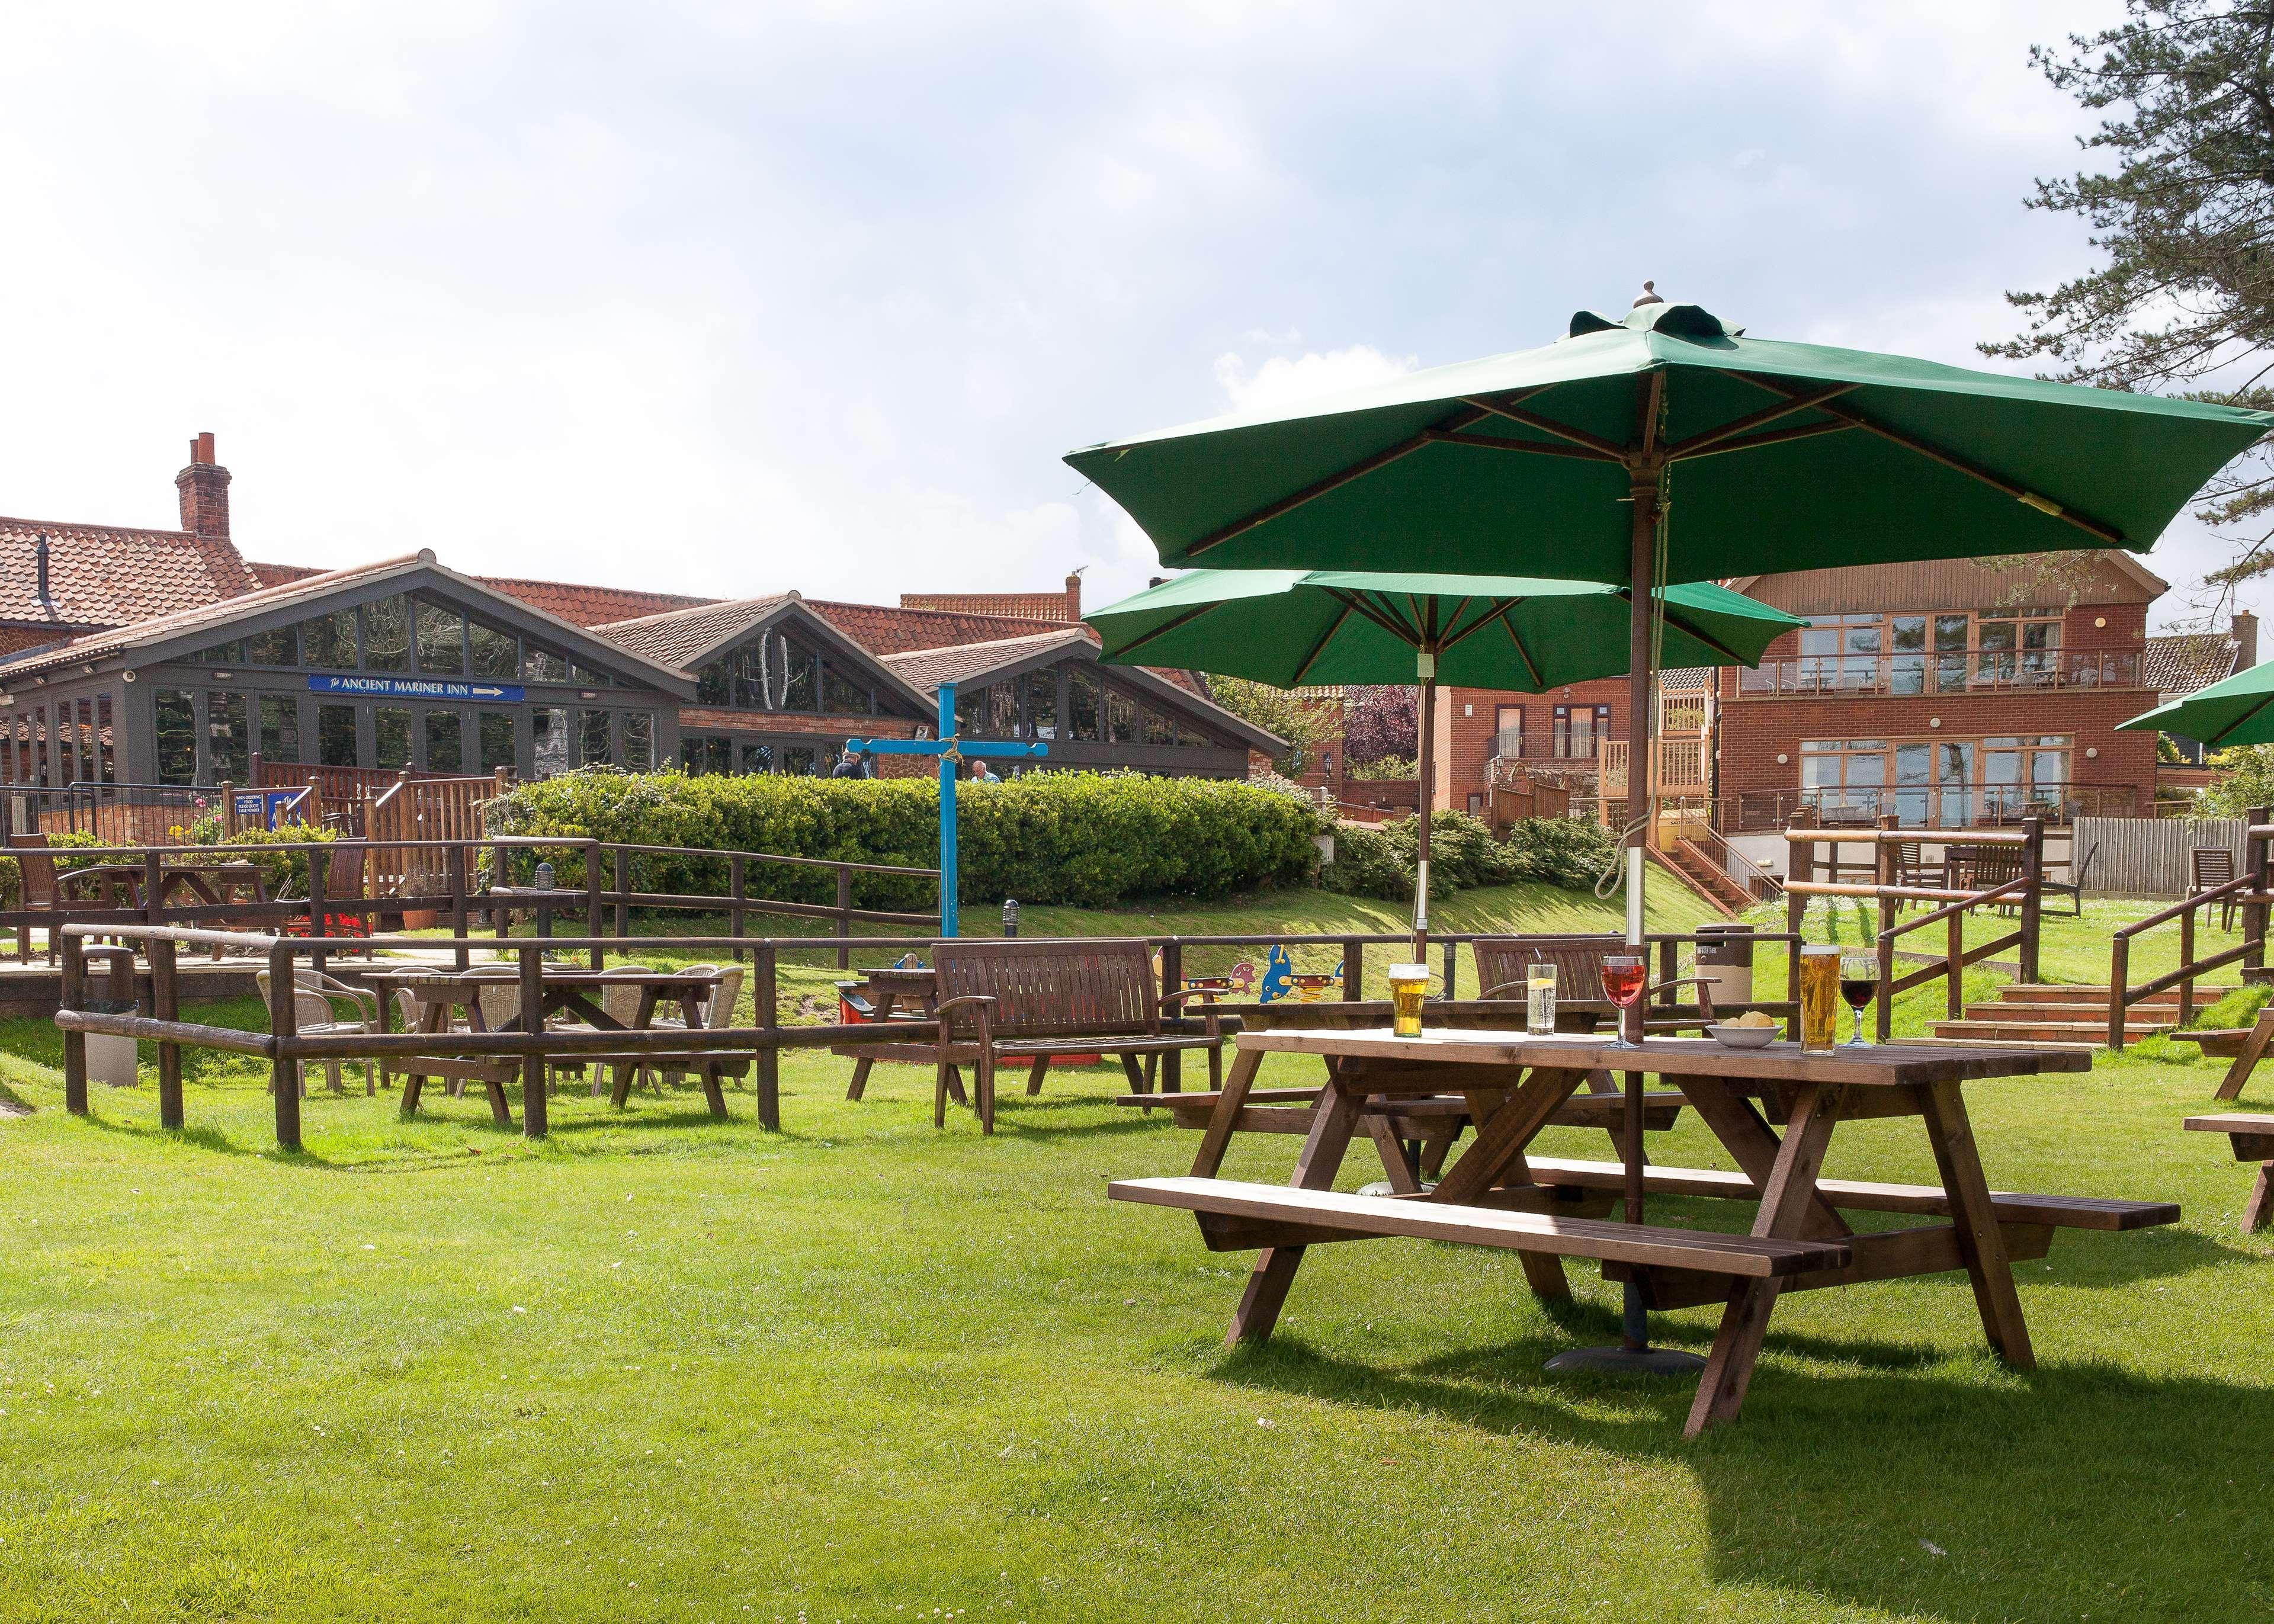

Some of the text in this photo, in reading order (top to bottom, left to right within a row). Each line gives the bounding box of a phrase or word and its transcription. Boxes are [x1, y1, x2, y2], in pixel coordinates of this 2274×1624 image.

[341, 678, 390, 691] ANCIENT
[394, 681, 444, 694] MARINER
[447, 684, 468, 695] INN
